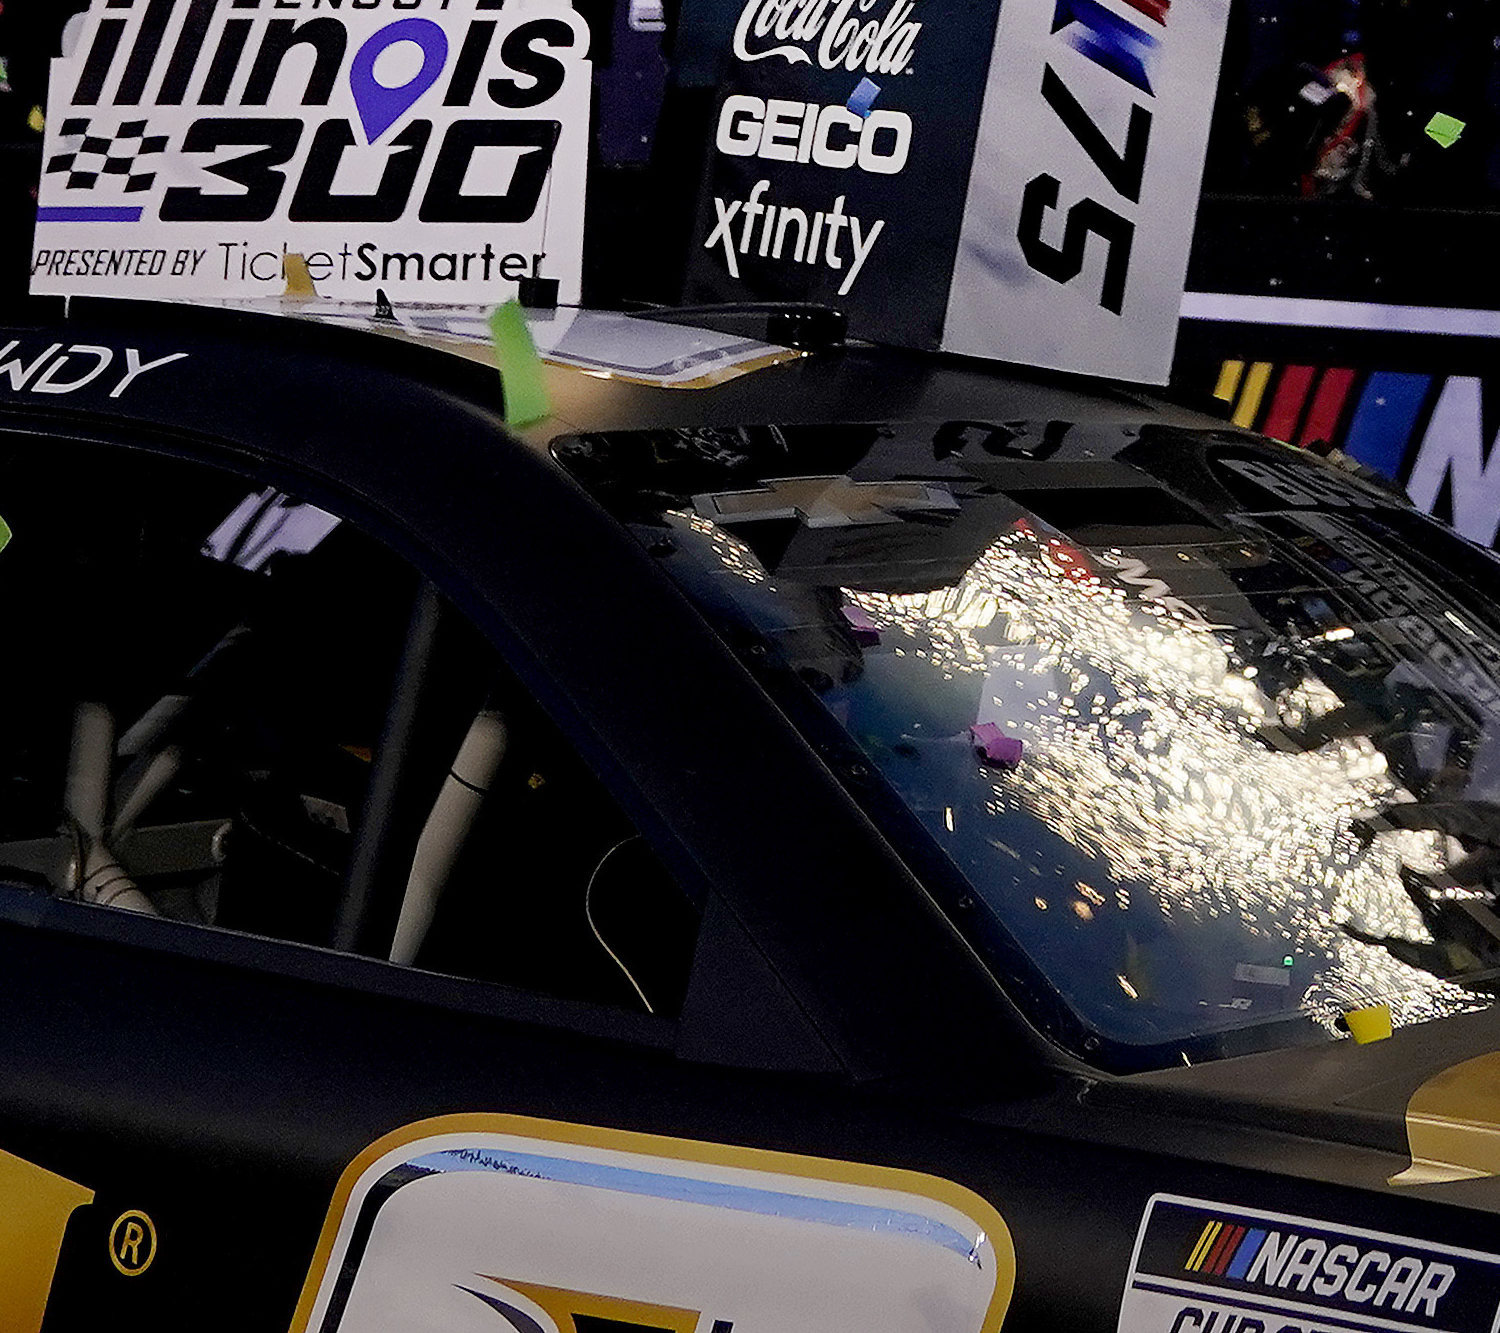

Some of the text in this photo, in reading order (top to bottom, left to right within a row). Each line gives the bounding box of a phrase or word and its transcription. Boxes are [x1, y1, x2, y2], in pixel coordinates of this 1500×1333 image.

[715, 93, 913, 175] GEICO
[1016, 62, 1155, 317] 75
[32, 248, 167, 278] PRESENTED
[171, 248, 208, 277] BY
[704, 179, 886, 296] xfinity
[1245, 1230, 1457, 1318] NASCAR
